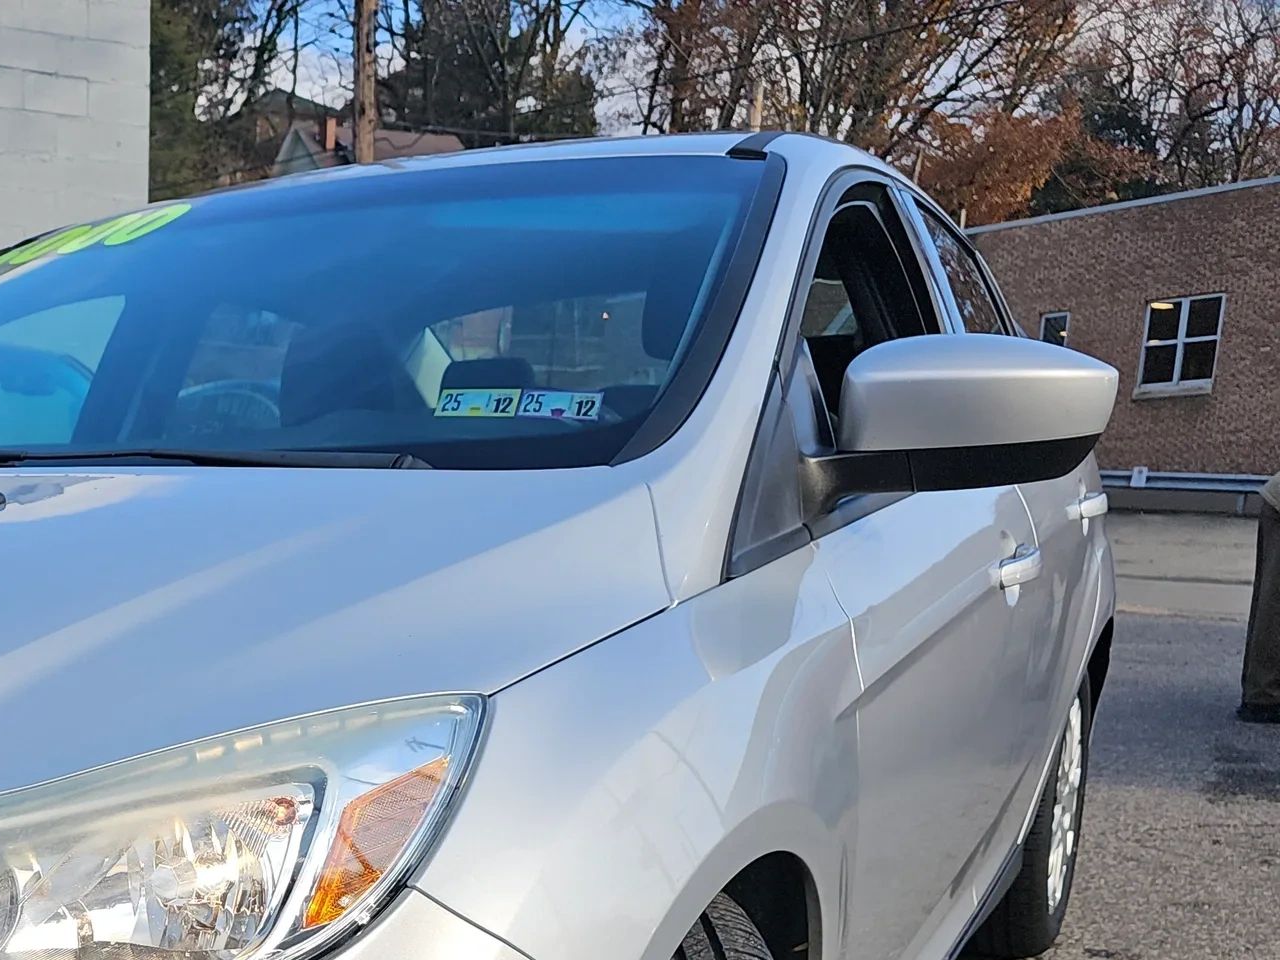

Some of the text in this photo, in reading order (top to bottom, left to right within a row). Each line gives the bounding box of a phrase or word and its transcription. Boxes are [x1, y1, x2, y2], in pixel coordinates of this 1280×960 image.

[441, 393, 514, 414] 25 12
[523, 393, 596, 417] 25 12
